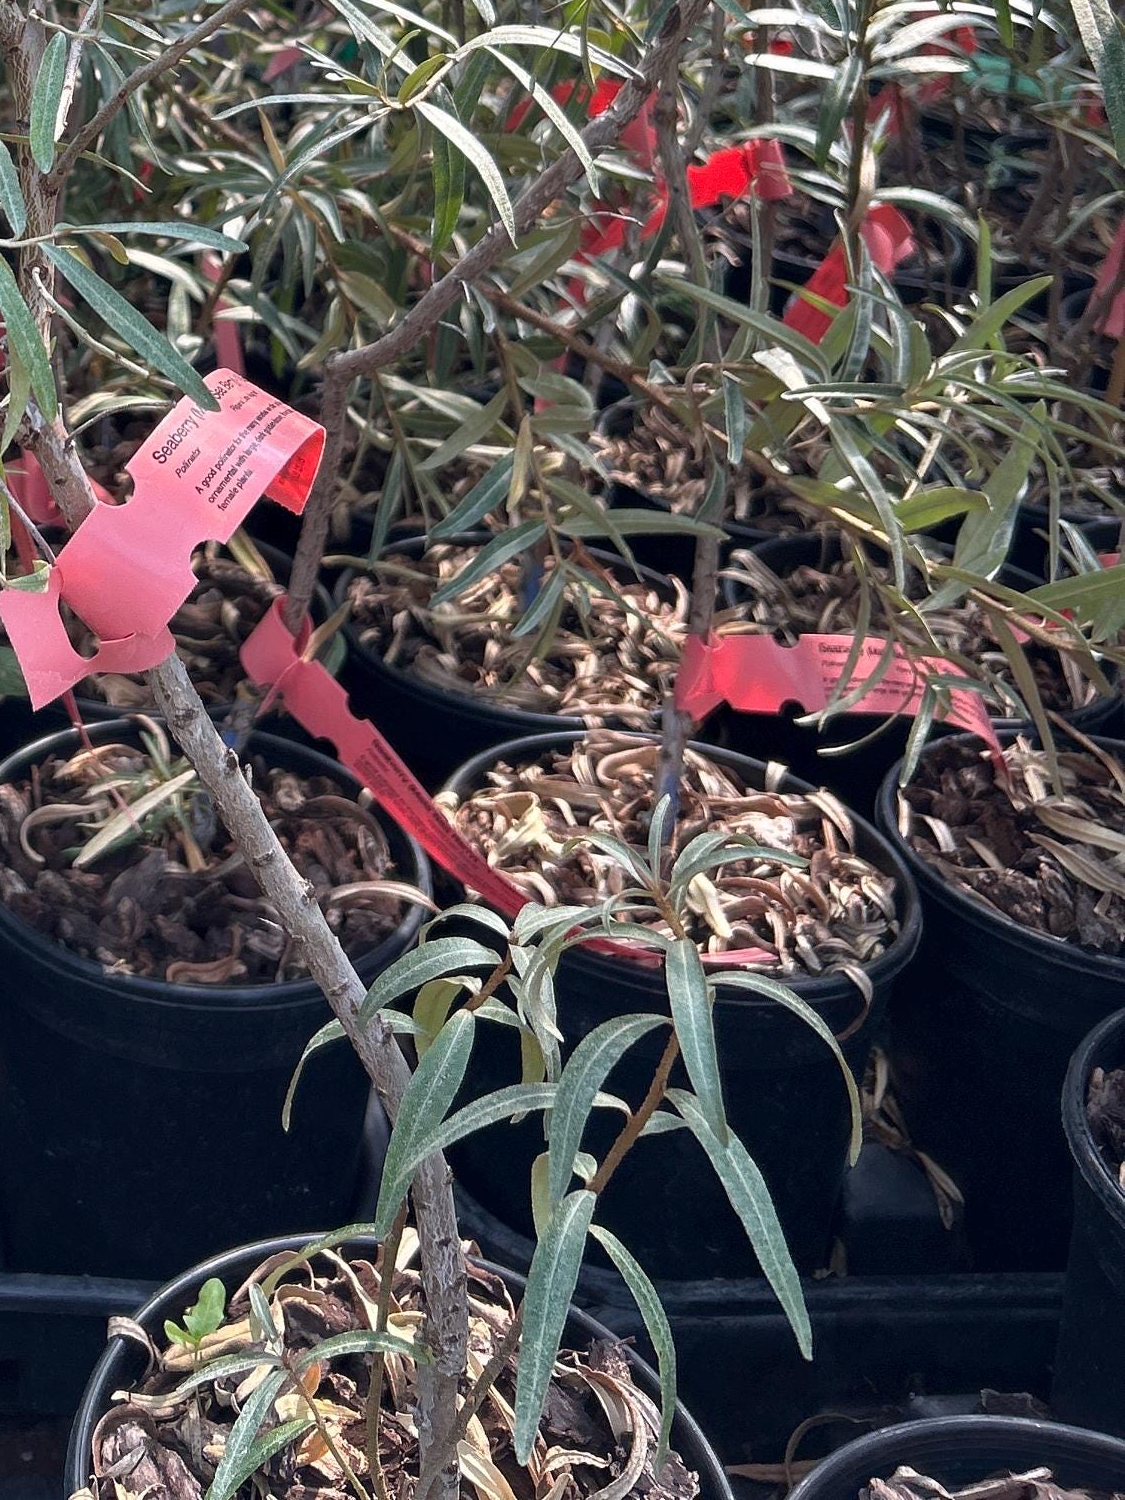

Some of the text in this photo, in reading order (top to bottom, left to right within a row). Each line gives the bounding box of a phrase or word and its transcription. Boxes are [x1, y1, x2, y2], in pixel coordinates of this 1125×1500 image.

[152, 416, 199, 464] Seaberry
[175, 448, 201, 479] Pollinator
[195, 486, 204, 495] A
[201, 467, 217, 488] good
[214, 443, 236, 471] pollinator
[232, 437, 242, 445] for
[238, 429, 250, 439] the
[208, 465, 238, 504] ornamental
[235, 455, 248, 467] with
[217, 487, 239, 512] female
